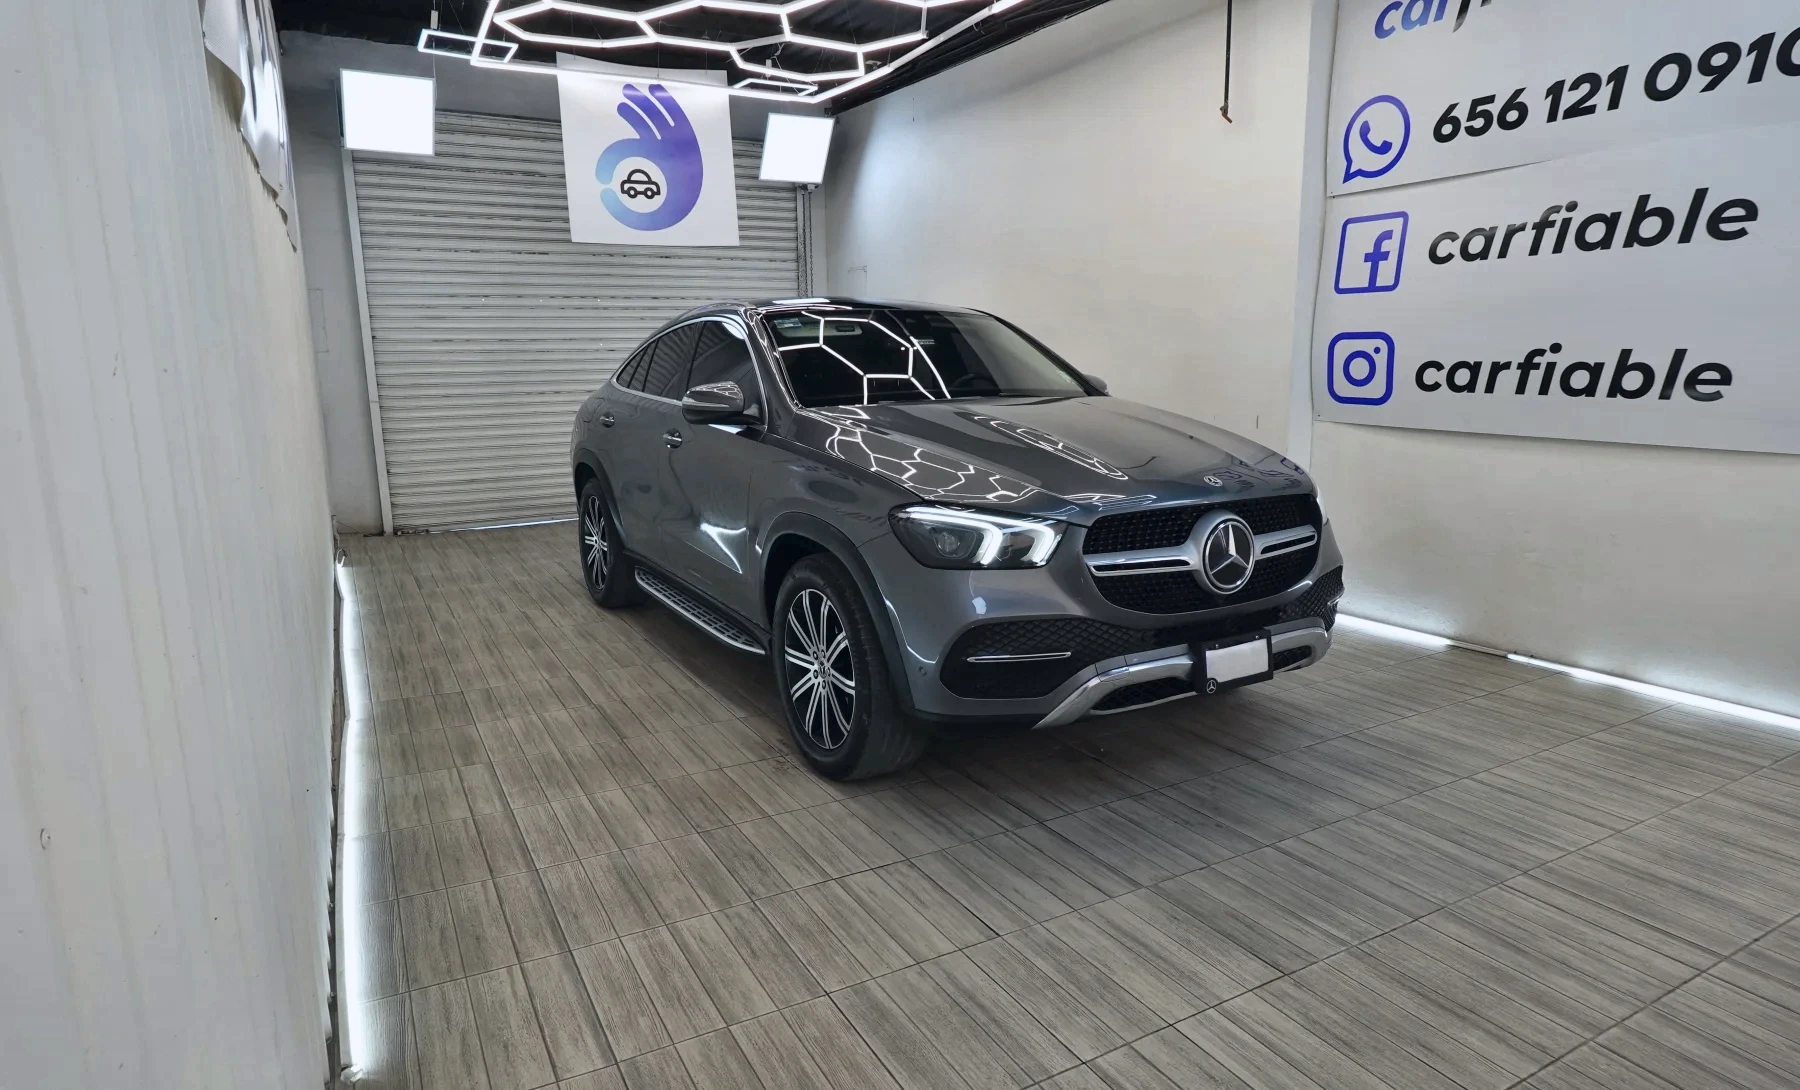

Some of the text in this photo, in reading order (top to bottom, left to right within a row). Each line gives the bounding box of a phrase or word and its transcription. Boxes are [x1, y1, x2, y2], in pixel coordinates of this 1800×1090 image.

[1432, 86, 1529, 144] 656
[1544, 64, 1630, 124] 121
[1428, 187, 1759, 265] carfiable
[1414, 342, 1734, 403] carfiable
